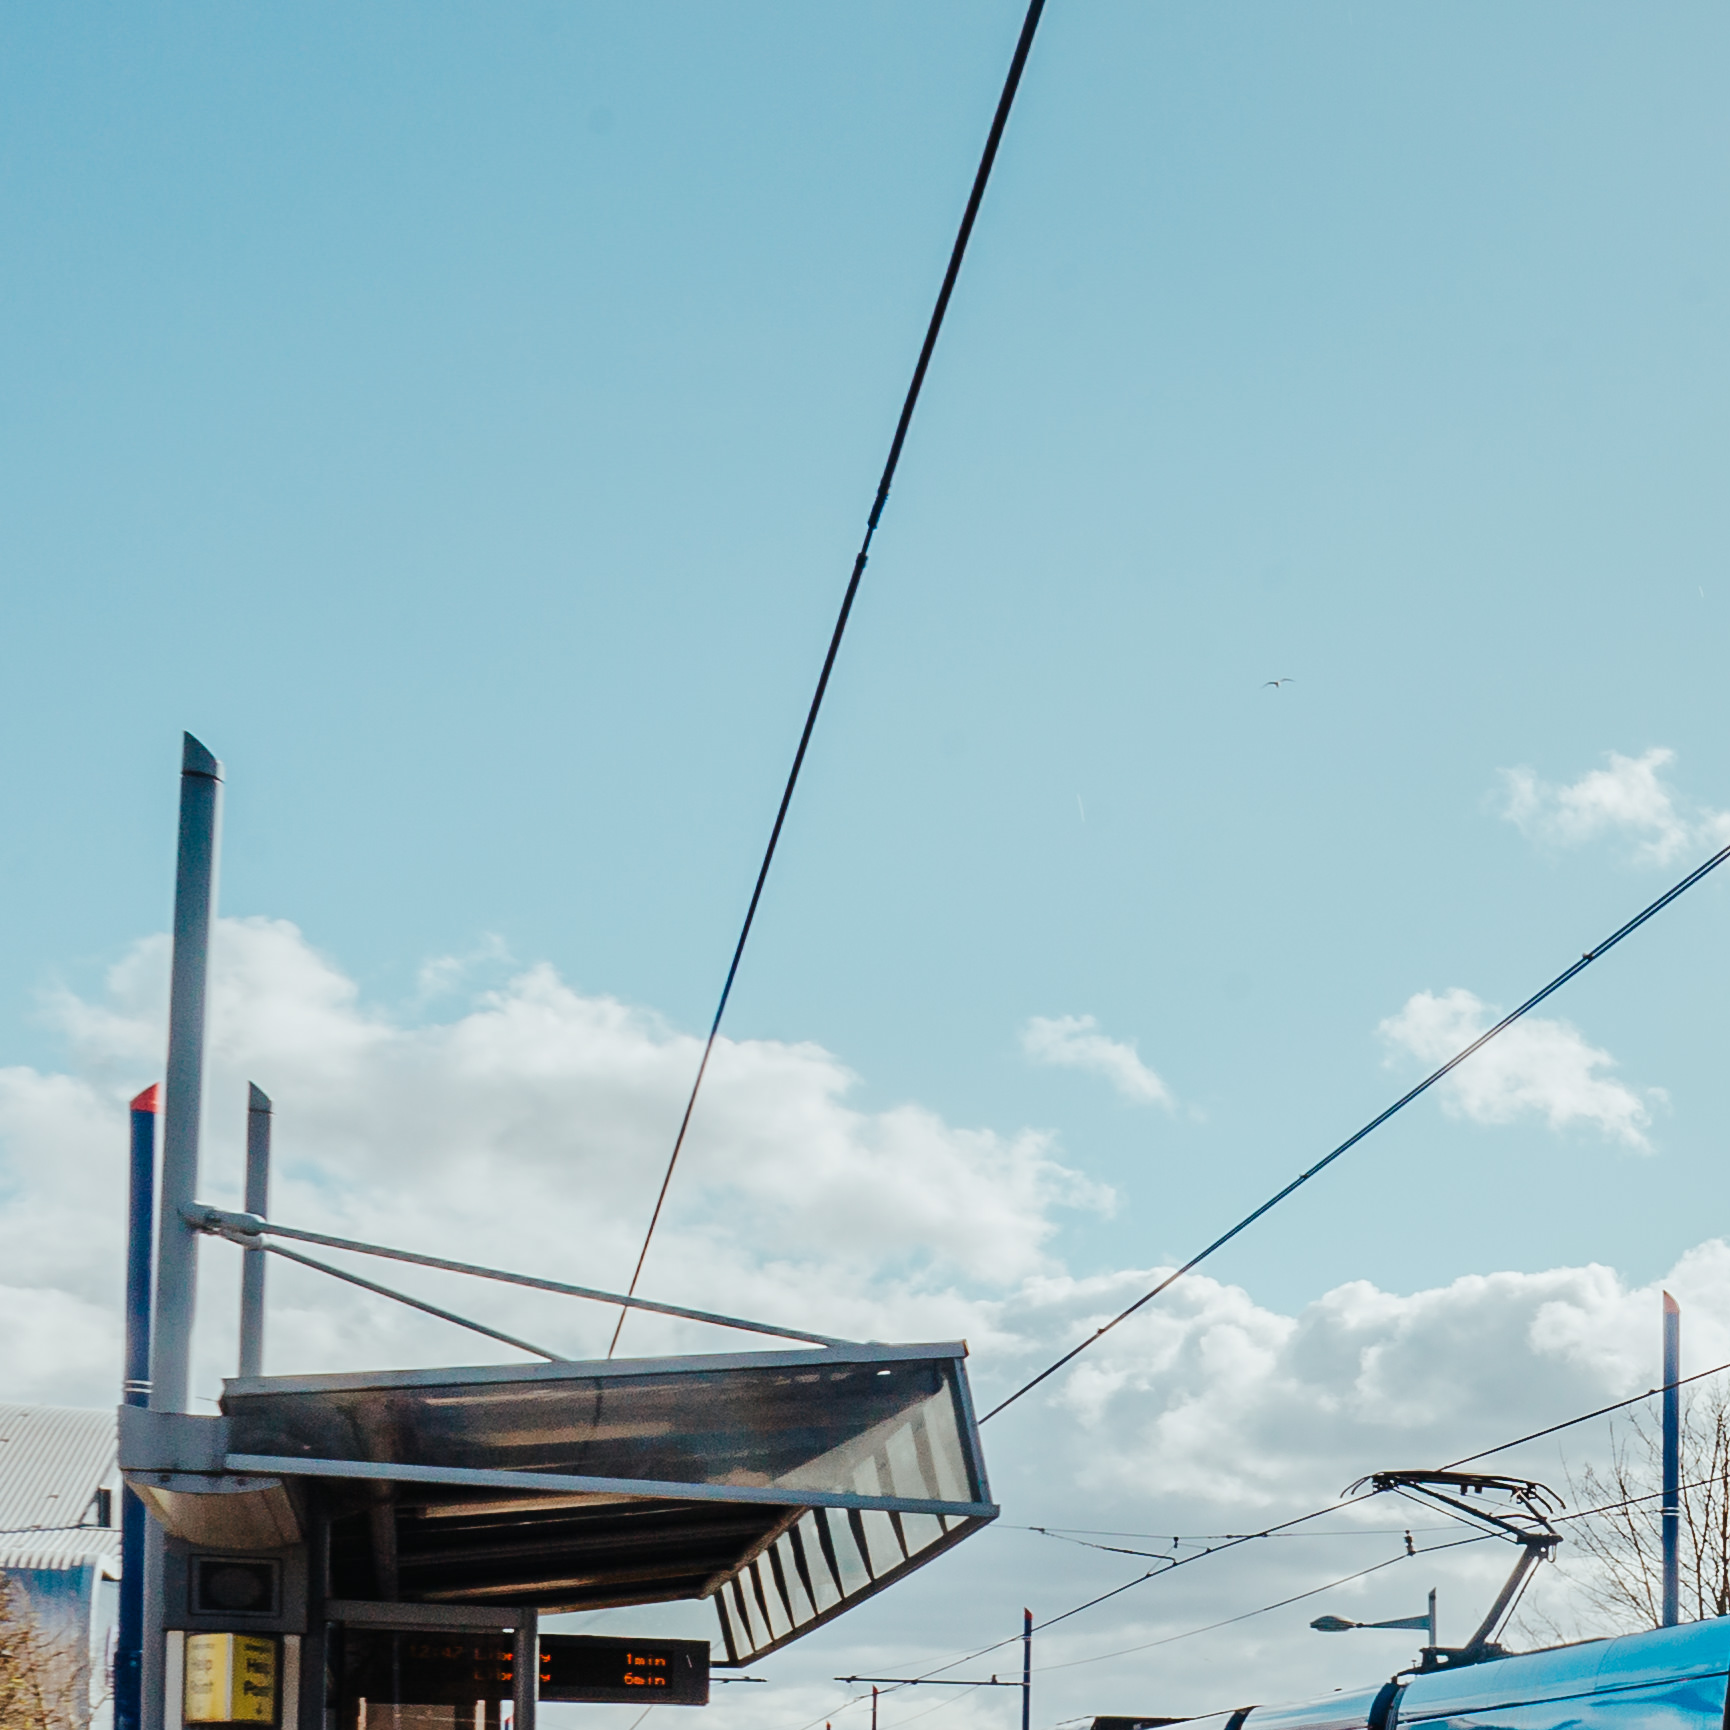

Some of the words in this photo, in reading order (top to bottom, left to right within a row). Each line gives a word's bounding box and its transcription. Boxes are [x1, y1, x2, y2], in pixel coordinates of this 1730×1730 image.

[474, 1648, 551, 1663] Libry
[626, 1653, 666, 1667] 1min
[474, 1667, 551, 1683] Libry
[623, 1672, 666, 1686] 6min
